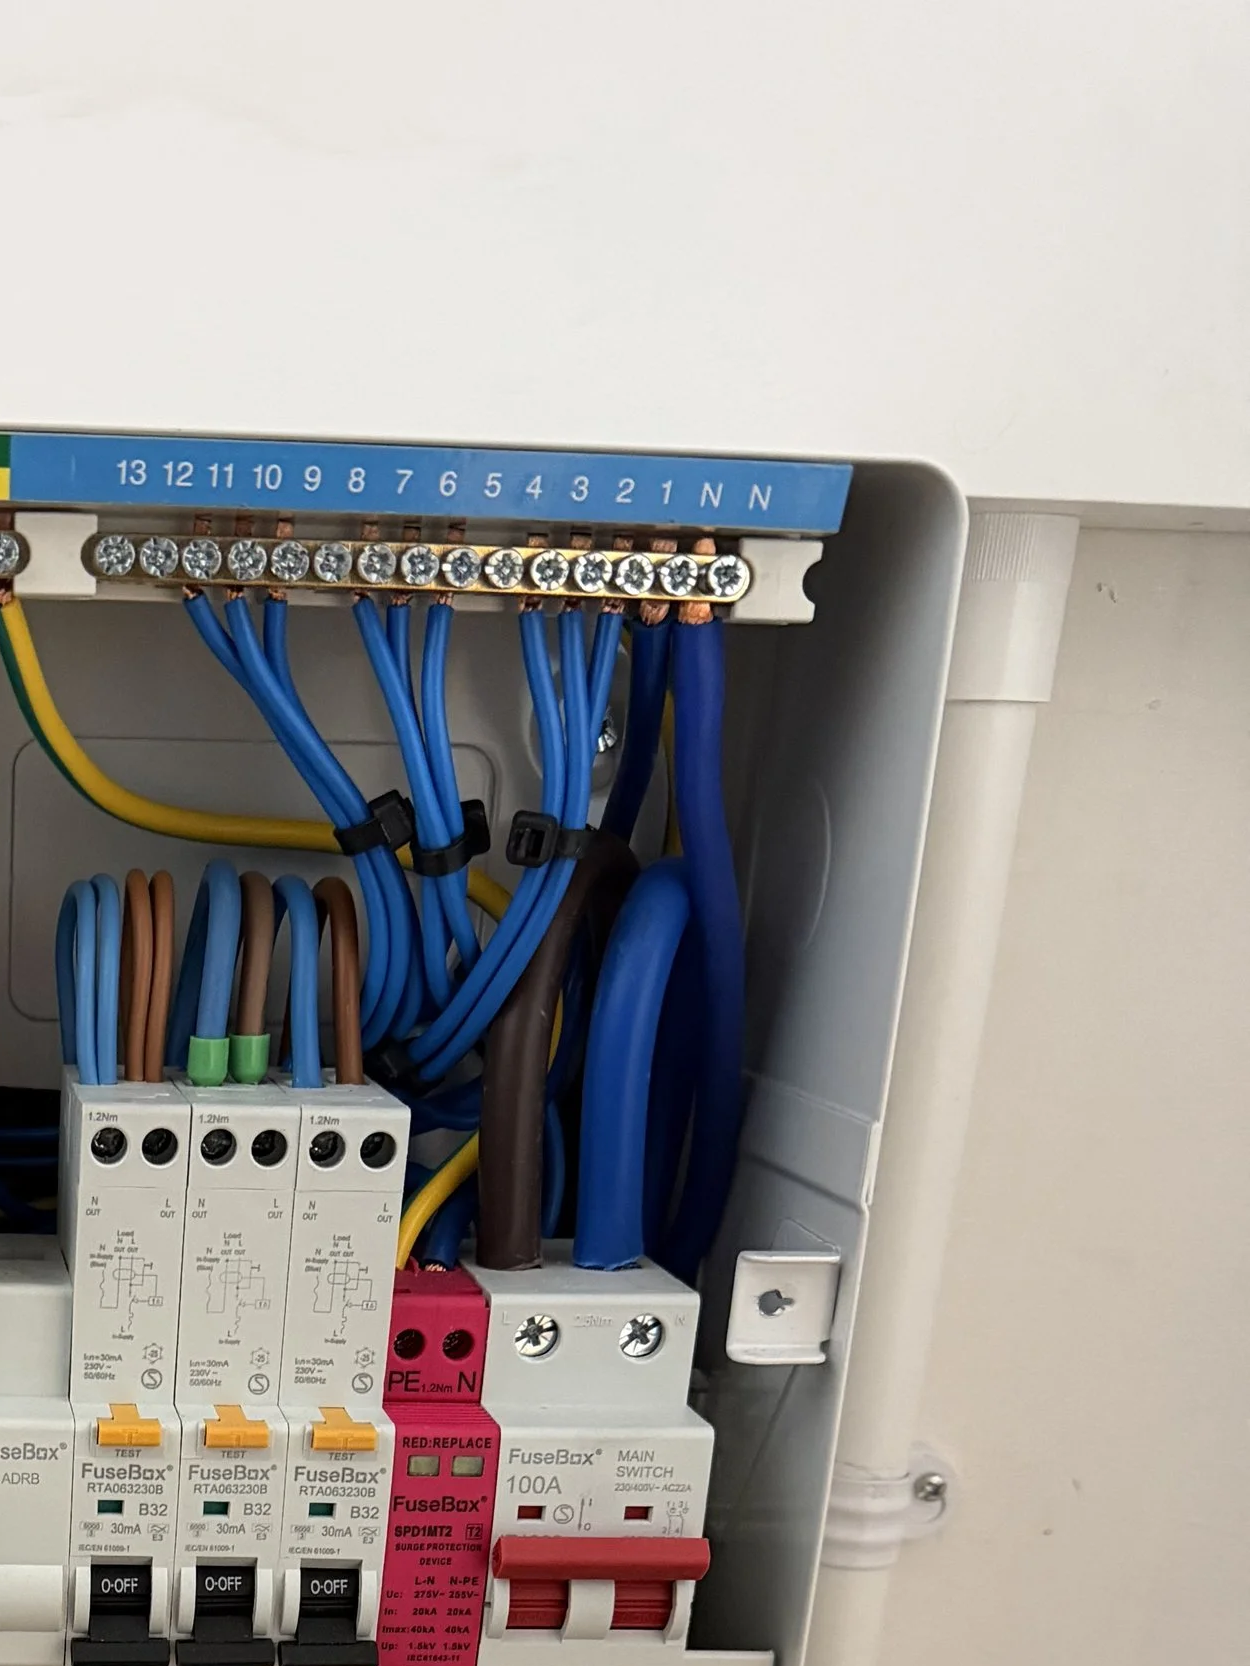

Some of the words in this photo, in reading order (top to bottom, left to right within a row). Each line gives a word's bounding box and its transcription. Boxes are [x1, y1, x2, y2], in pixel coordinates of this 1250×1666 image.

[116, 458, 147, 486] 13
[162, 461, 194, 488] 12
[208, 462, 235, 489] 11
[253, 463, 283, 491] 10
[303, 464, 321, 492] 9
[348, 467, 366, 494] 8
[396, 468, 414, 495] 7
[440, 469, 457, 497] 6
[484, 471, 503, 499] 5
[525, 473, 544, 500] 4
[571, 475, 591, 502] 3
[615, 477, 634, 504] 2
[661, 478, 673, 504] 1
[701, 480, 724, 507] N
[750, 483, 774, 511] N
[388, 1371, 421, 1392] PE
[457, 1371, 477, 1392] N
[115, 1449, 142, 1458] TEST
[221, 1450, 247, 1459] TEST
[328, 1452, 356, 1461] TEST
[617, 1449, 655, 1463] MAIN
[616, 1465, 674, 1478] SWITCH
[1, 1472, 40, 1485] ADRB
[87, 1483, 164, 1495] RTA063230B
[193, 1483, 268, 1495] RTA063230B
[506, 1475, 562, 1495] 100A
[299, 1486, 376, 1498] RTA063230B
[138, 1503, 168, 1516] B32
[243, 1503, 272, 1516] B32
[350, 1506, 380, 1520] B32
[110, 1523, 142, 1535] 30mA
[216, 1523, 246, 1535] 30mA
[321, 1525, 352, 1538] 30mA
[395, 1525, 453, 1537] SPD1MT2
[467, 1526, 481, 1537] T2
[395, 1543, 426, 1551] SURGE
[427, 1543, 482, 1552] PROTECTION
[420, 1557, 452, 1565] DEVICE
[415, 1576, 435, 1585] L-N
[449, 1577, 479, 1586] N-PE
[412, 1607, 438, 1616] 20kA
[446, 1608, 472, 1616] 20kA
